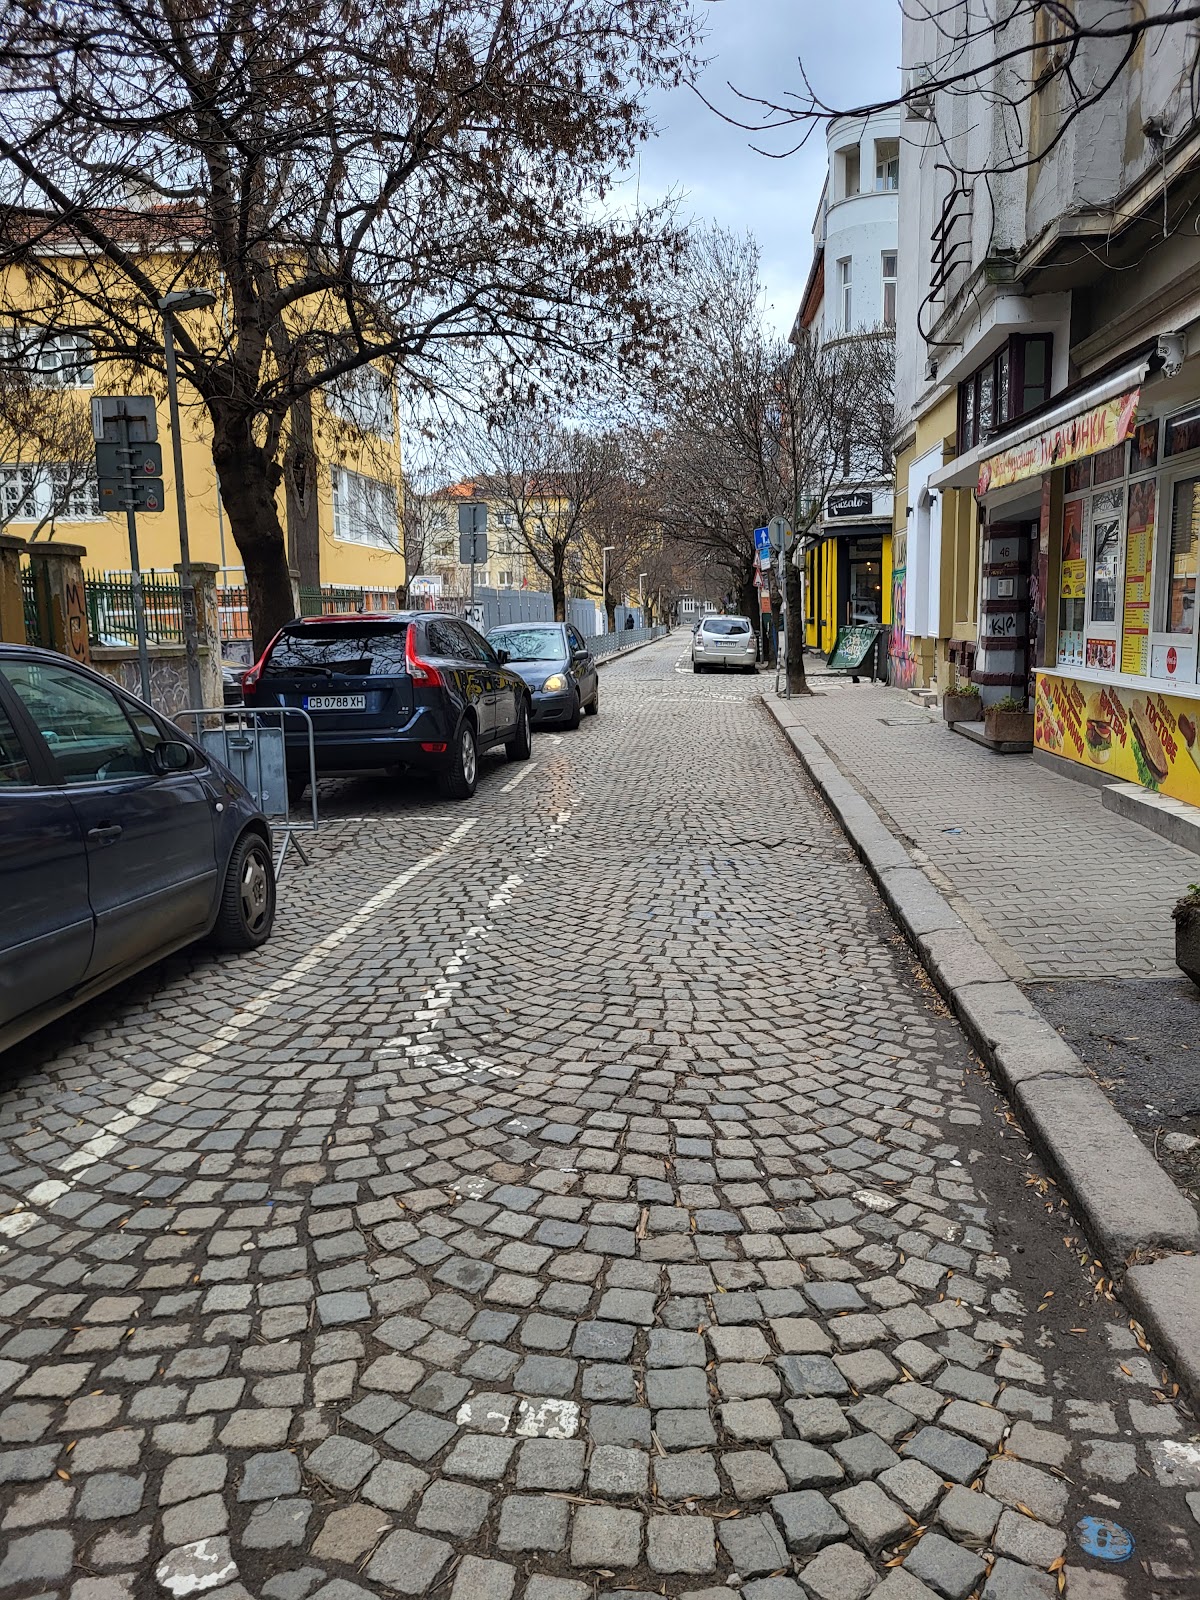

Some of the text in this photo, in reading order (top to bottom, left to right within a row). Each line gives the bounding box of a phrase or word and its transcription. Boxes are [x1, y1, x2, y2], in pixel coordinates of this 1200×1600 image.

[1000, 547, 1010, 558] 46
[294, 681, 367, 689] VOLVO
[309, 696, 364, 708] CB 0788 XH
[1145, 695, 1178, 764] ТОСТОВЕ
